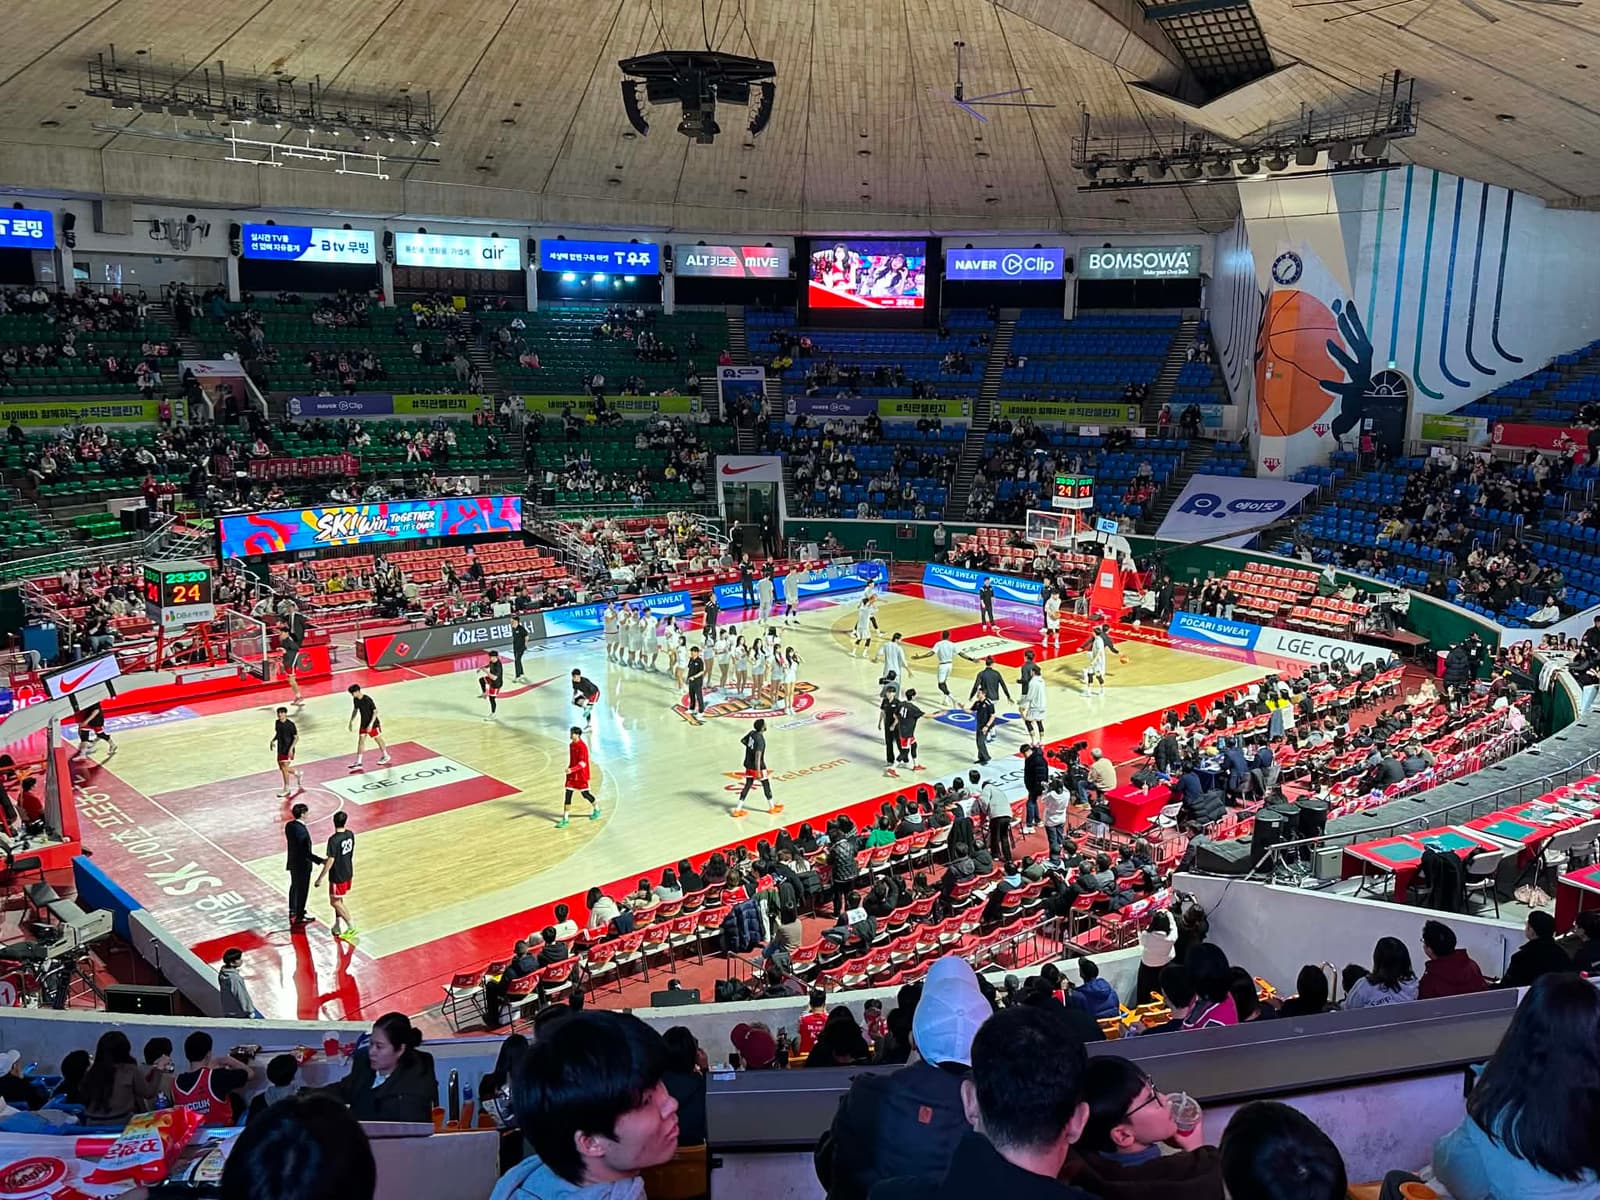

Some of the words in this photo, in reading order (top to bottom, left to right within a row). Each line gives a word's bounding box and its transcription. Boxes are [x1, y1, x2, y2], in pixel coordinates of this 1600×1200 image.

[11, 219, 44, 238] 로밍
[321, 240, 332, 252] B
[333, 241, 346, 252] tv
[482, 245, 505, 260] air
[613, 251, 626, 265] T
[626, 251, 651, 267] 우주
[955, 260, 997, 270] NAVER
[1023, 256, 1055, 274] Clip
[1089, 252, 1190, 269] BOMSOWA
[2, 408, 39, 421] 네이버와
[1058, 485, 1073, 497] 24
[1080, 486, 1091, 497] 24
[1236, 501, 1278, 512] 에이닷
[931, 566, 955, 576] POCARI
[955, 570, 979, 580] SWEAT
[989, 577, 1014, 587] POCARI
[1015, 581, 1040, 592] SWEAT
[172, 584, 202, 604] 24
[1180, 617, 1216, 631] POCARI
[1216, 624, 1252, 637] SWEAT
[452, 627, 489, 647] KBL은
[1276, 635, 1366, 667] LGE.COM
[771, 757, 852, 782] telecom
[346, 764, 457, 795] LGE.COM
[110, 826, 177, 868] 나이츠
[341, 838, 353, 855] 23
[144, 860, 223, 896] SK
